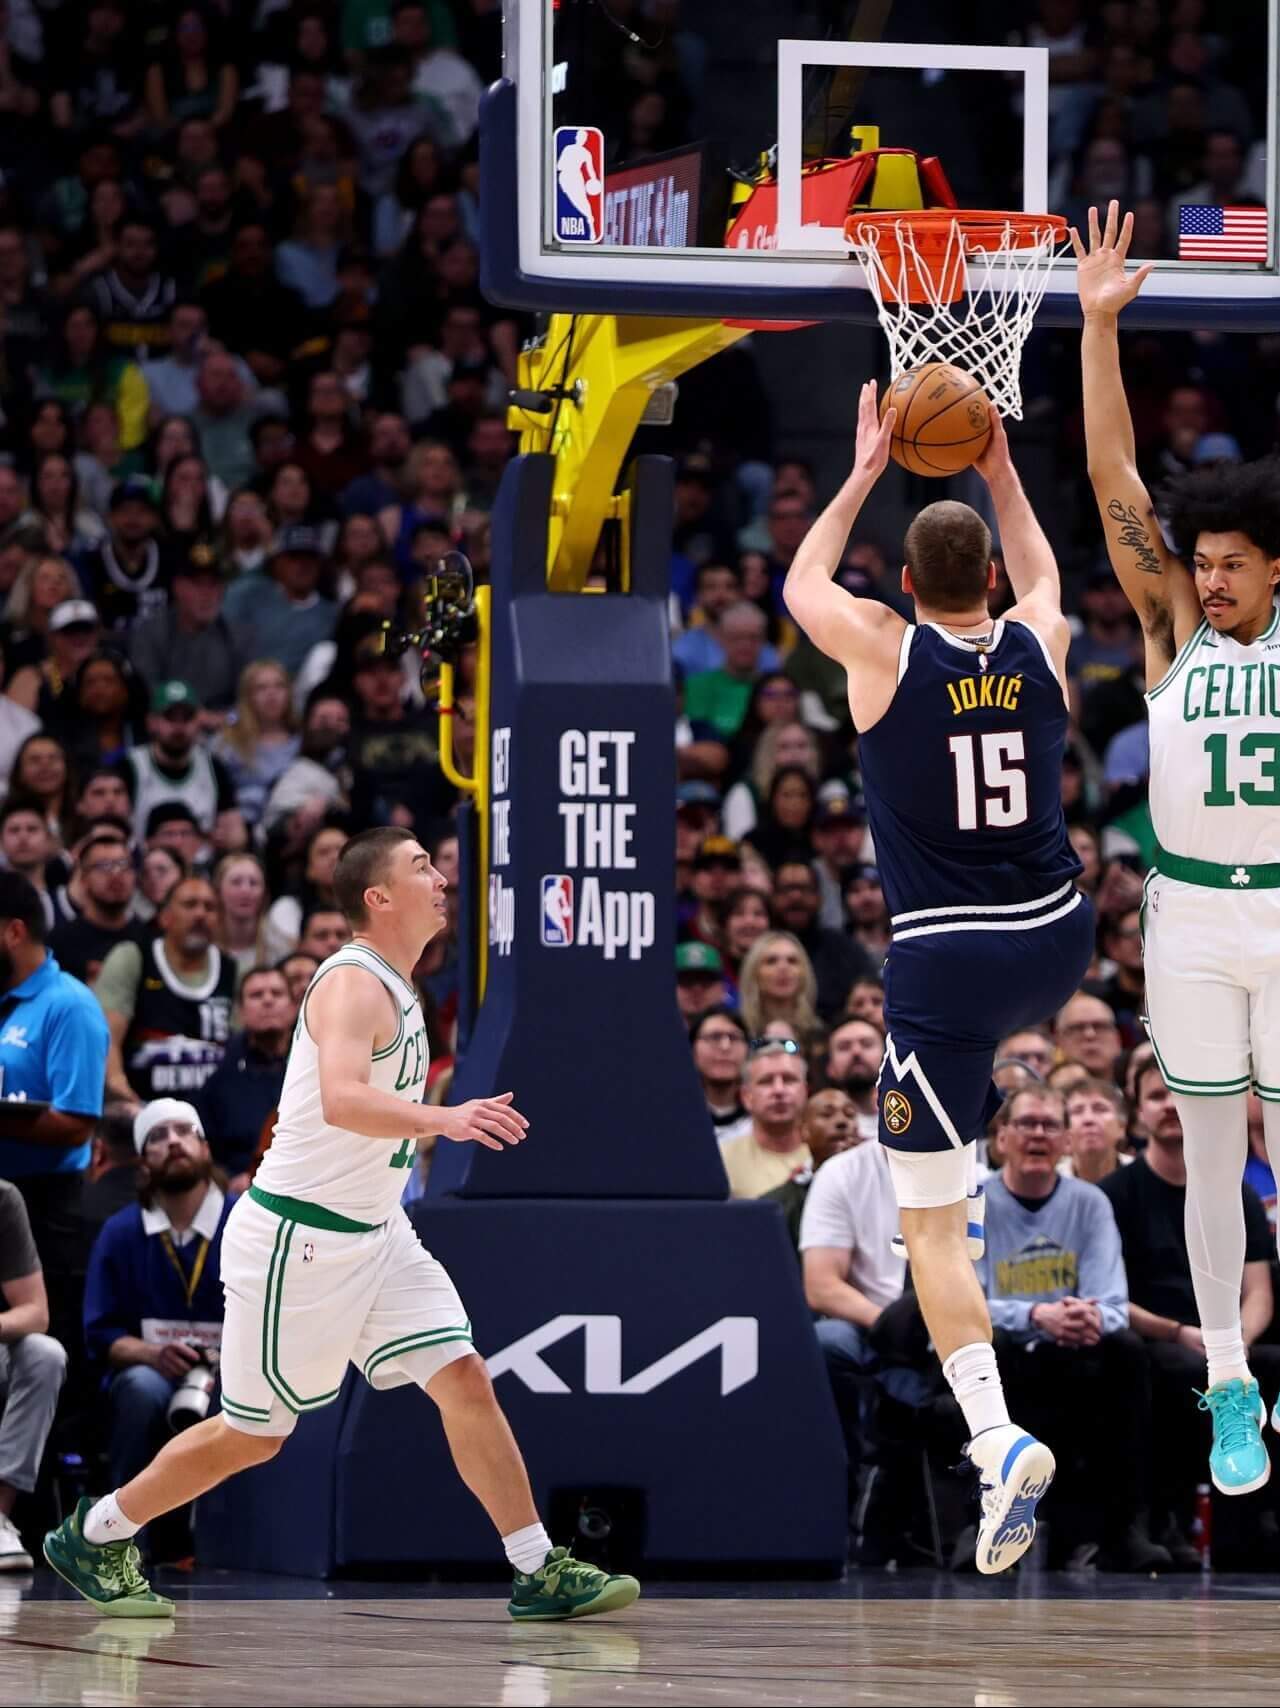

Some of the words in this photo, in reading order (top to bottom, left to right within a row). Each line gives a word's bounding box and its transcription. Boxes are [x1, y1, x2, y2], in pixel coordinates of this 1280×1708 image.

[561, 217, 585, 235] NBA
[947, 673, 1024, 716] JOKIĆ
[559, 729, 636, 797] GET
[948, 730, 1028, 831] 15
[558, 801, 638, 869] THE
[576, 876, 656, 960] App
[151, 1064, 219, 1091] DENV
